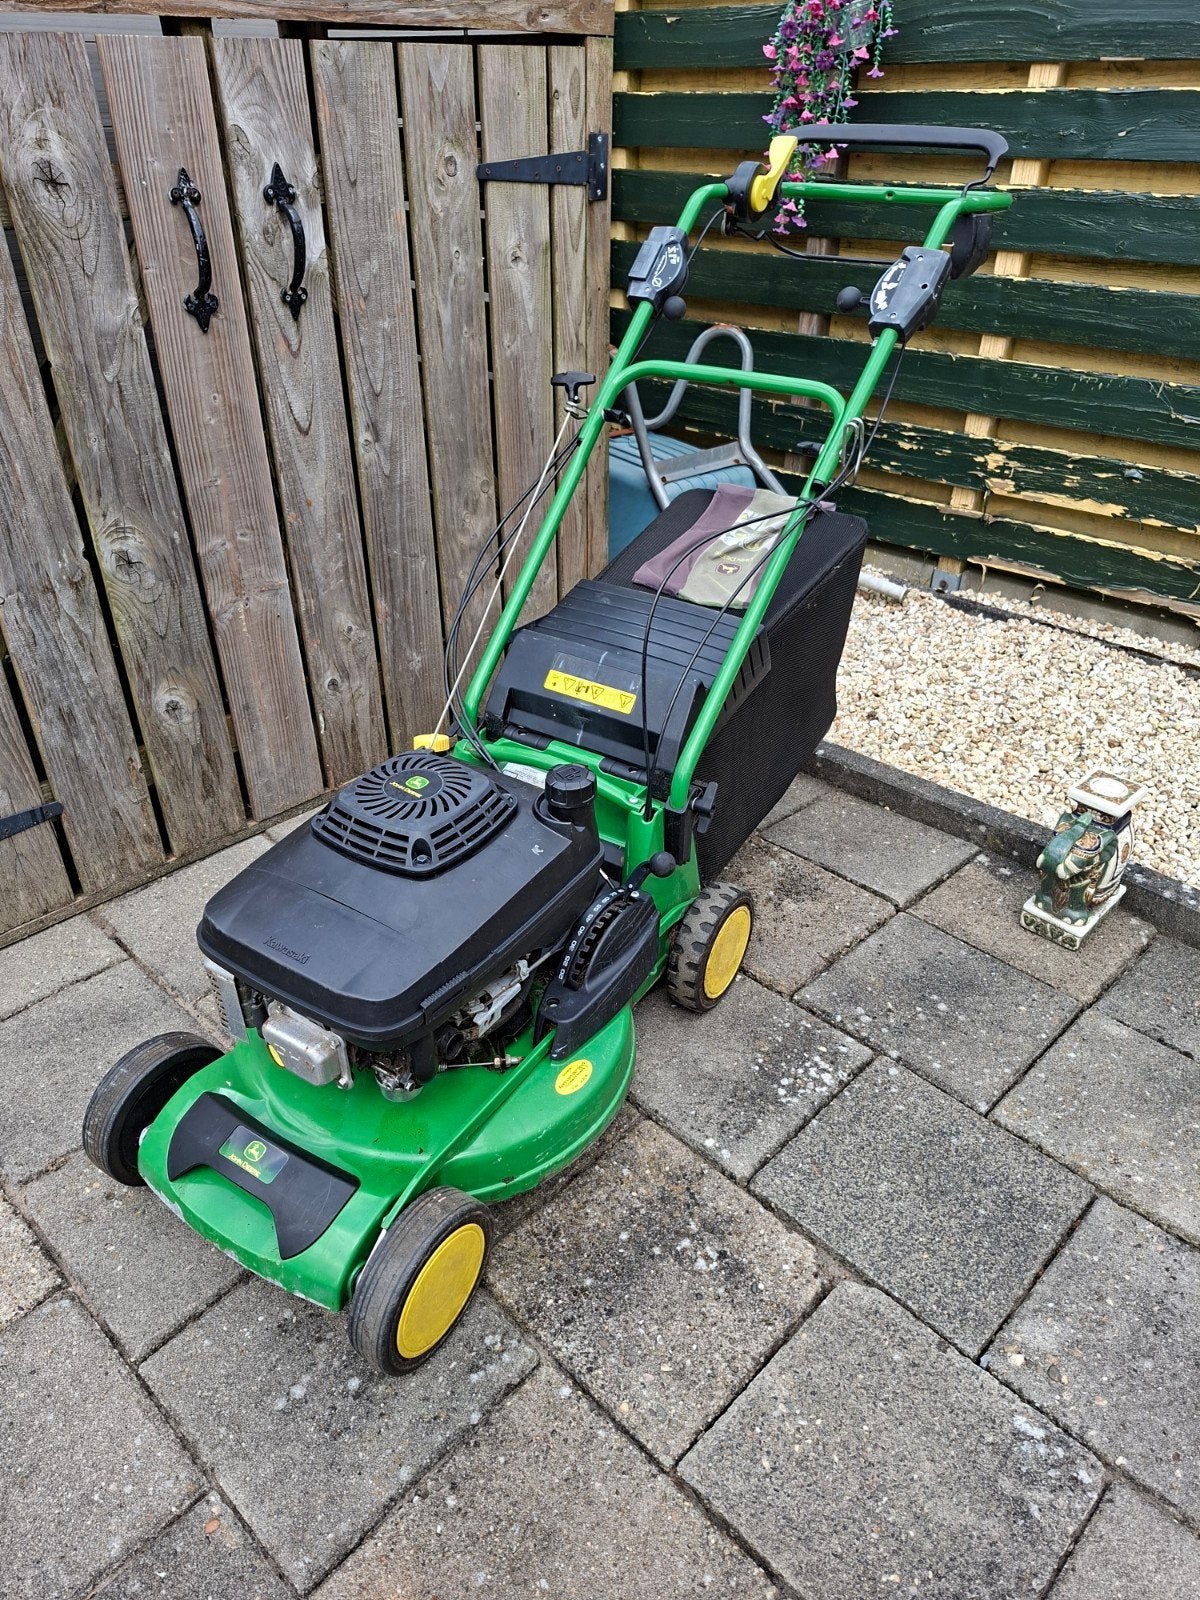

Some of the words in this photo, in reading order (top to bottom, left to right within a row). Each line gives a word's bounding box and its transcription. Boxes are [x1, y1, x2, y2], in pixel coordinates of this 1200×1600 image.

[389, 781, 405, 790] JOHN
[263, 935, 311, 965] Kawasaki
[558, 968, 565, 980] 20
[562, 955, 570, 967] 25
[568, 940, 577, 952] 30
[577, 926, 585, 936] 40
[585, 913, 594, 923] 45
[228, 1154, 243, 1166] JOHN
